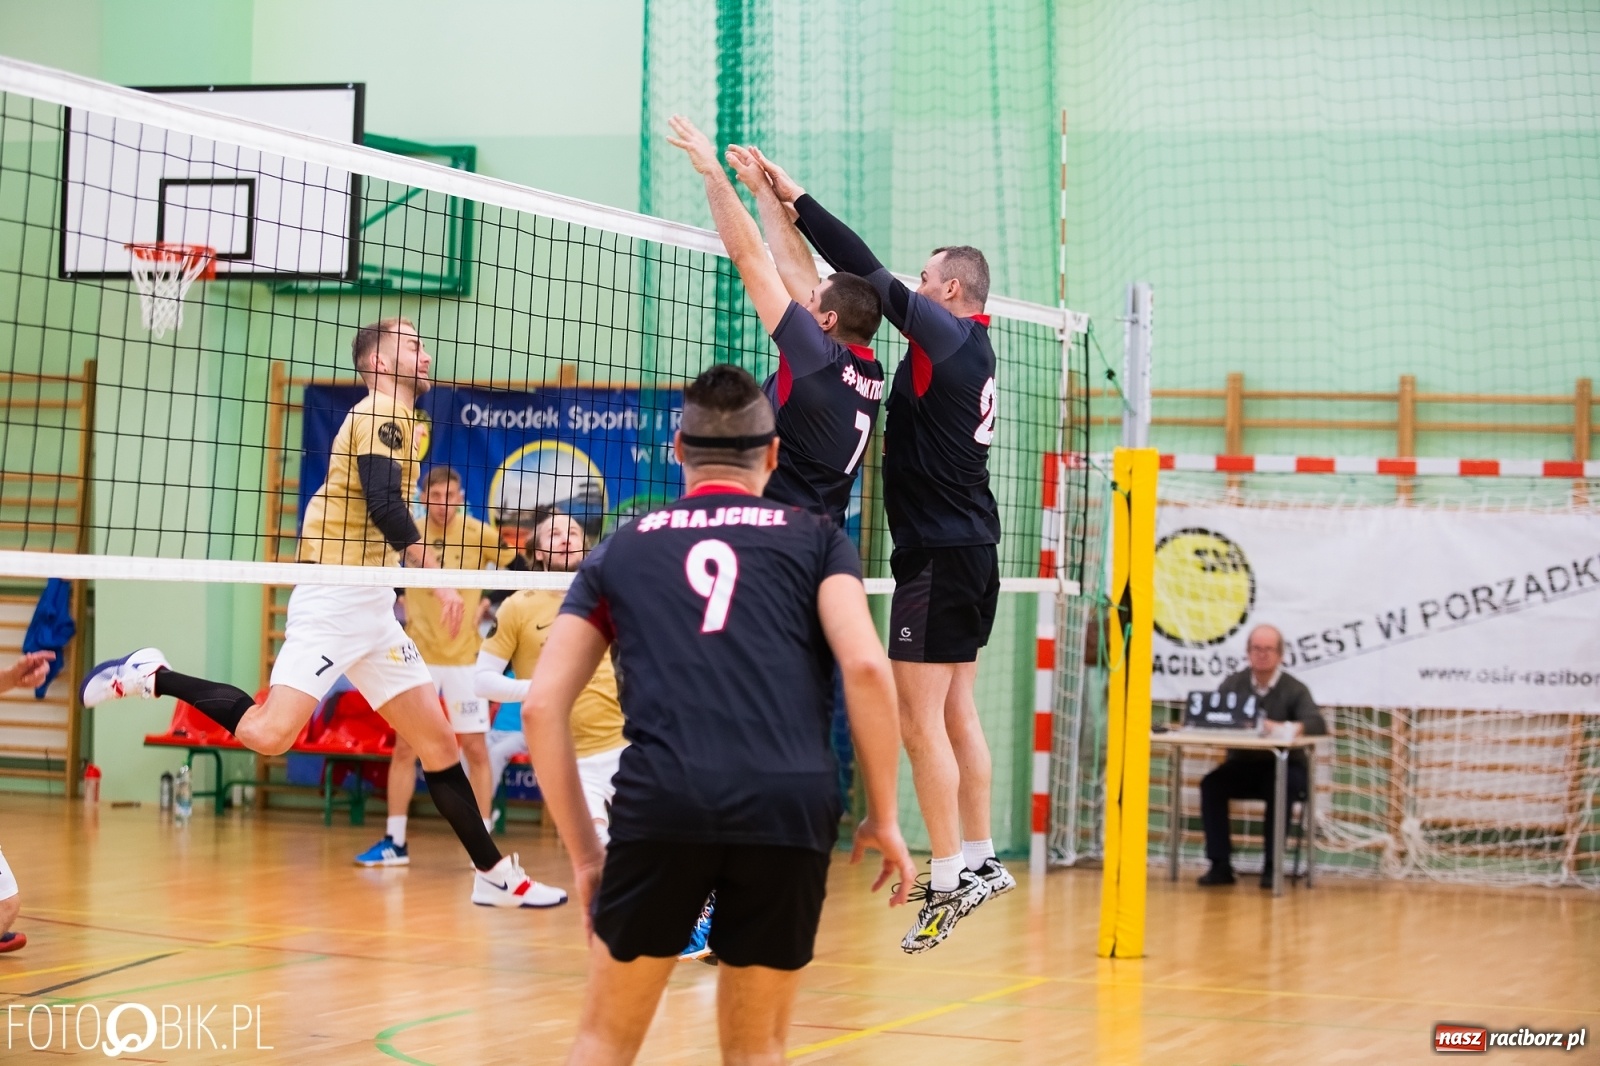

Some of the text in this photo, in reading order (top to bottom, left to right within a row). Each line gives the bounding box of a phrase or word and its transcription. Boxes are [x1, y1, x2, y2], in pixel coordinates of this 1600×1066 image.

[460, 402, 556, 429] Ośrodek
[566, 404, 648, 434] Sportu
[655, 409, 663, 431] i
[845, 410, 871, 475] 7
[636, 506, 788, 533] #RAJCHEL
[685, 538, 738, 633] 9
[1375, 606, 1406, 640] W
[315, 654, 334, 677] 7
